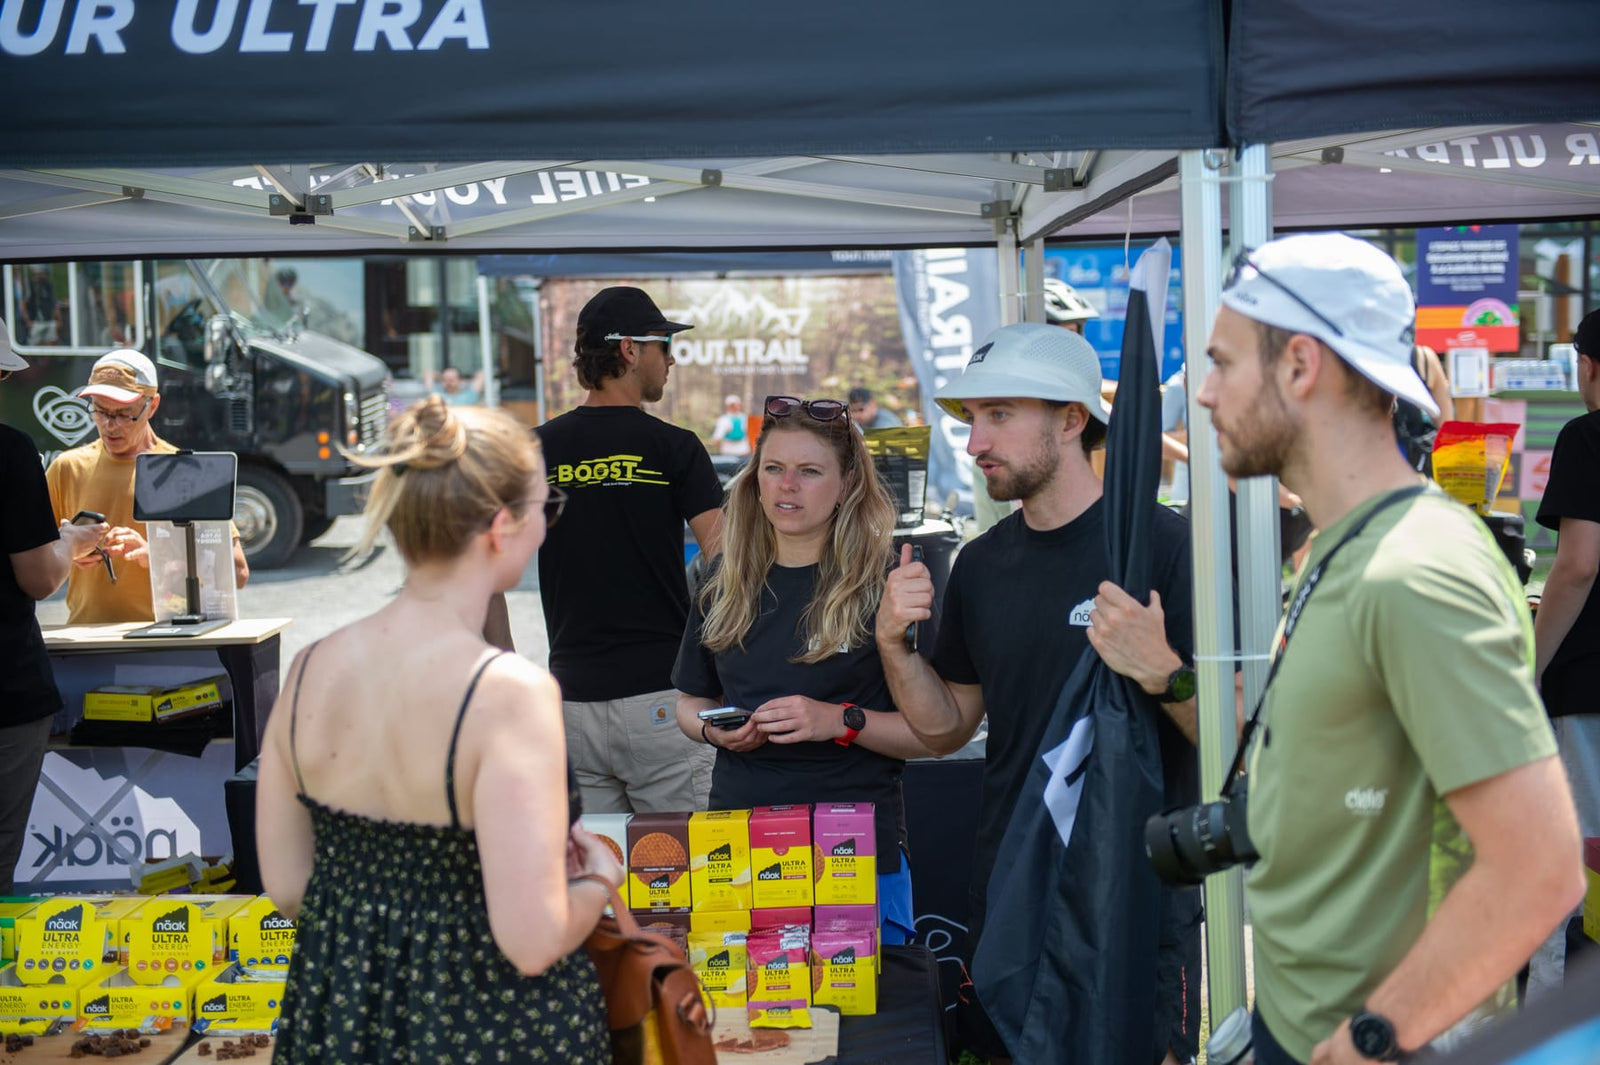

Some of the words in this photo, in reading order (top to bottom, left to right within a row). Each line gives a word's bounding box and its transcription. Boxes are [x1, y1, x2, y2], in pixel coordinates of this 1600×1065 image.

[170, 0, 491, 54] ULTRA
[558, 461, 638, 482] BOOST
[48, 918, 79, 930] näak
[156, 919, 186, 931] näak
[263, 917, 294, 929] näak
[43, 932, 80, 942] ULTRA
[152, 934, 189, 943] ULTRA
[260, 931, 297, 941] ULTRA
